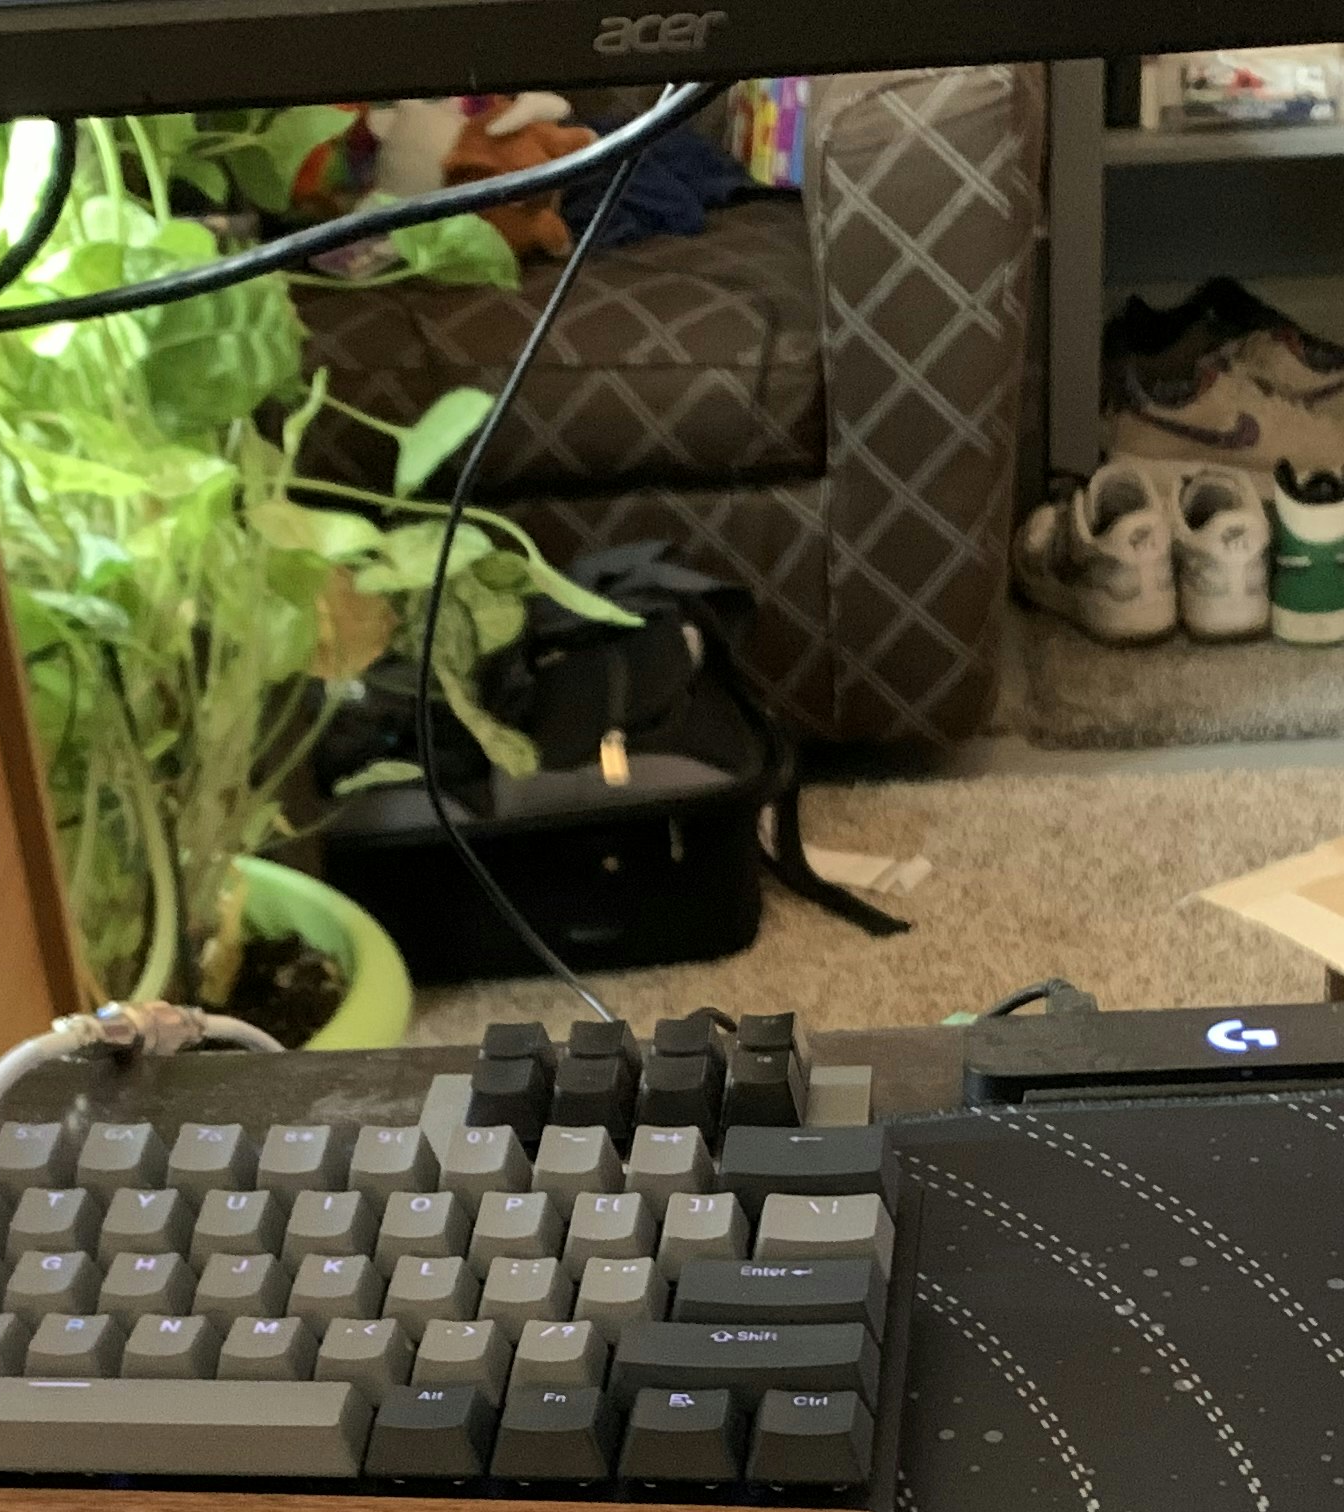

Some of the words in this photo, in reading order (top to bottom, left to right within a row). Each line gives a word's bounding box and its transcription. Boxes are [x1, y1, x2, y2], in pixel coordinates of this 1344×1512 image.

[593, 10, 728, 52] acer
[47, 1192, 64, 1207] T
[138, 1194, 156, 1208] Y
[227, 1195, 247, 1210] U
[410, 1197, 431, 1212] O
[506, 1198, 524, 1212] P
[41, 1255, 63, 1270] G
[134, 1257, 156, 1271] H
[231, 1259, 250, 1273] J
[323, 1259, 344, 1273] K
[419, 1261, 434, 1276] L
[740, 1265, 788, 1277] Enter
[159, 1320, 182, 1333] N
[253, 1321, 280, 1334] M
[736, 1330, 778, 1342] Shift
[417, 1391, 444, 1401] Alt
[543, 1392, 567, 1403] Fn
[793, 1395, 828, 1406] Ctrl
